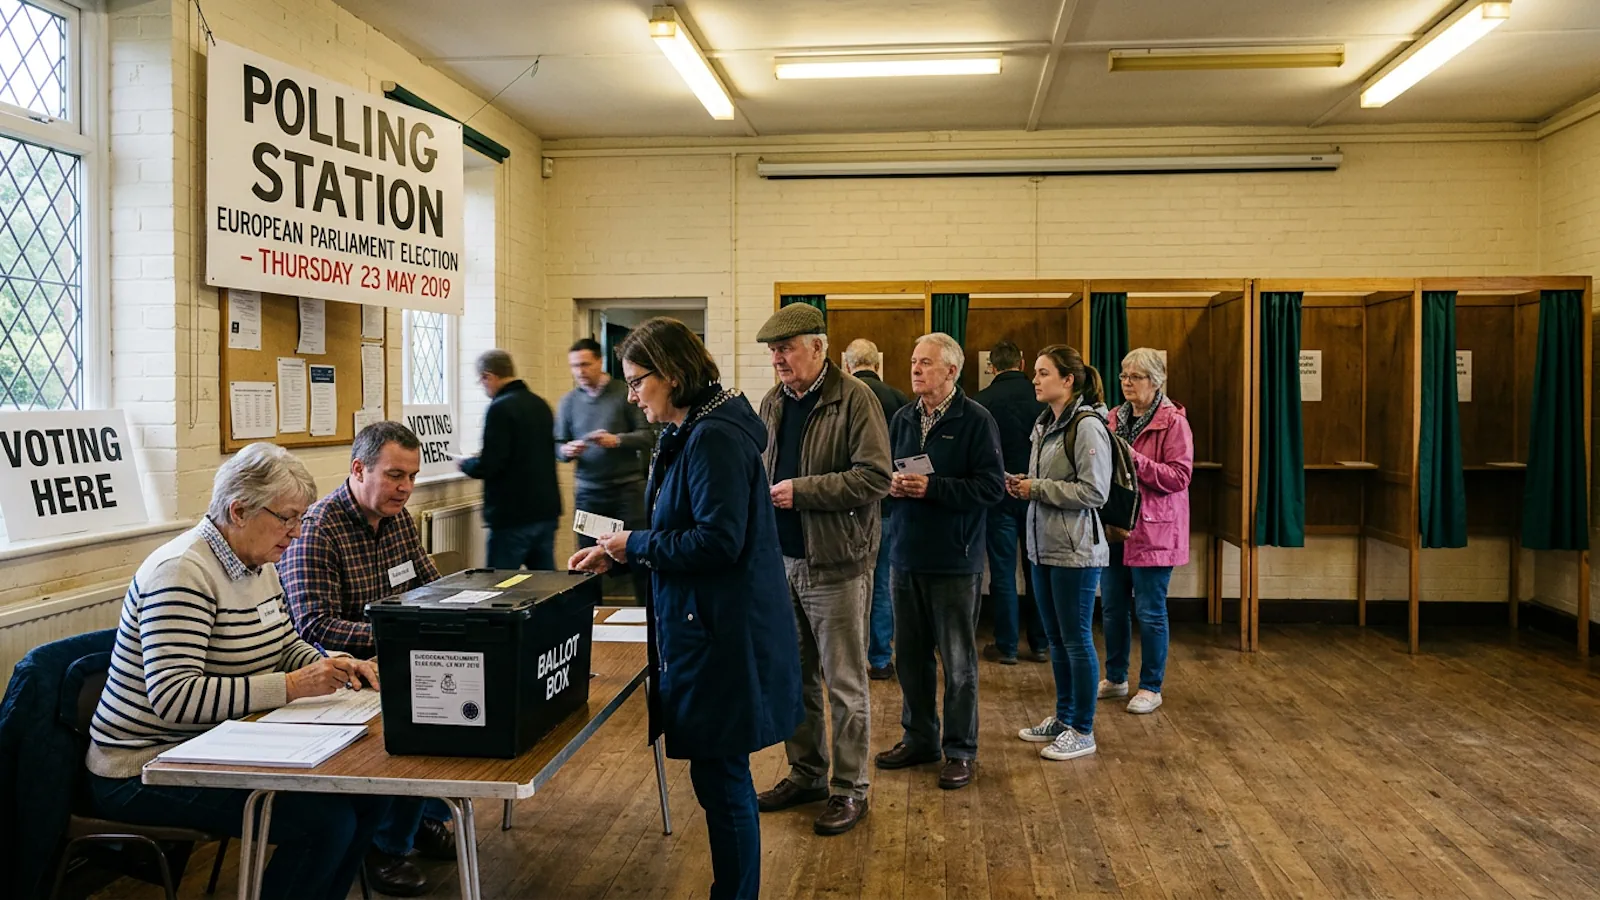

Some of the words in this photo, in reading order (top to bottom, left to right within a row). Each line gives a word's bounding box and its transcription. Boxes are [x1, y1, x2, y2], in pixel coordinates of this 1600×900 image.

[243, 64, 438, 173] POLLING
[251, 141, 443, 238] STATION
[217, 206, 303, 245] EUROPEAN
[310, 225, 395, 261] PARLIAMENT
[401, 242, 458, 272] ELECTION
[258, 247, 354, 286] THURSDAY
[361, 265, 380, 290] 23
[386, 269, 416, 294] MAY
[421, 275, 451, 299] 2019
[0, 426, 123, 468] VOTING
[407, 414, 453, 436] VOTING
[30, 473, 118, 517] HERE
[537, 632, 580, 680] BALLOT
[545, 664, 570, 701] BOX
